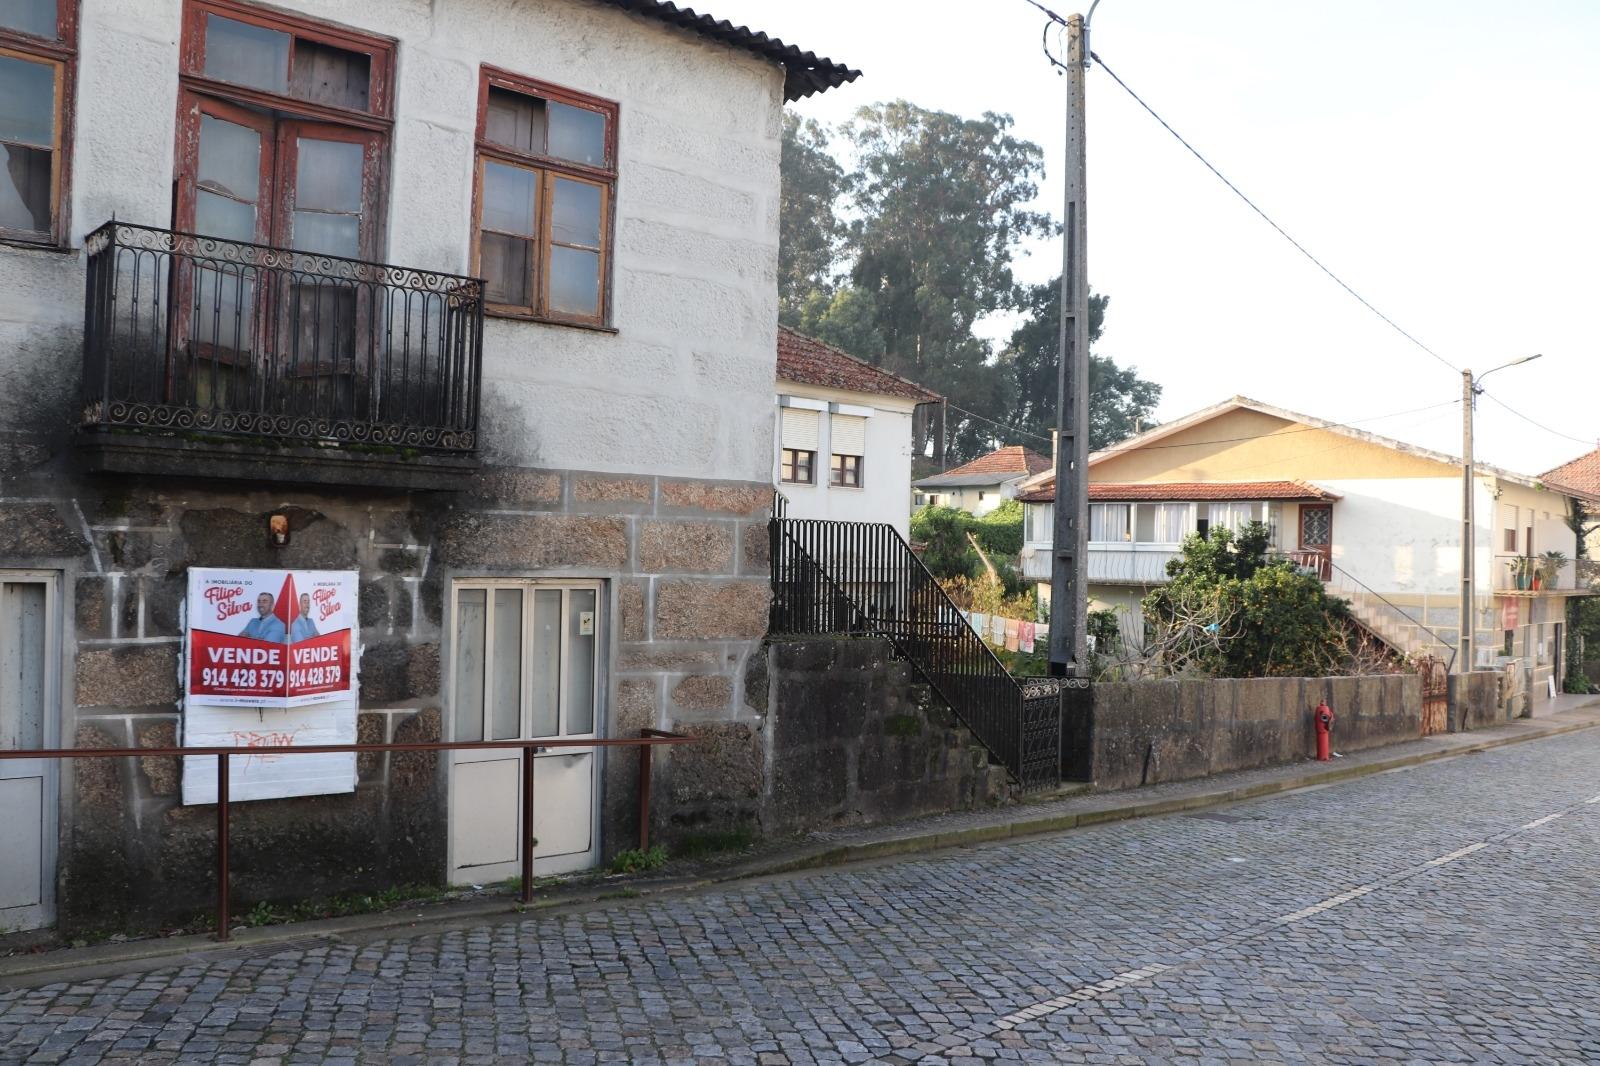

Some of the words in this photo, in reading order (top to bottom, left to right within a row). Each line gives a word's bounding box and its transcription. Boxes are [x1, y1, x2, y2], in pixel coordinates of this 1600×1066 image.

[204, 586, 243, 605] Filipe
[312, 587, 336, 607] Filipe
[217, 600, 253, 621] Silva
[319, 601, 342, 622] Silva
[208, 647, 280, 665] VENDE
[293, 646, 339, 665] VENDE
[202, 667, 228, 686] 914
[231, 668, 257, 688] 428
[260, 669, 285, 688] 379
[290, 668, 306, 688] 914
[307, 666, 323, 686] 428
[325, 665, 341, 684] 379
